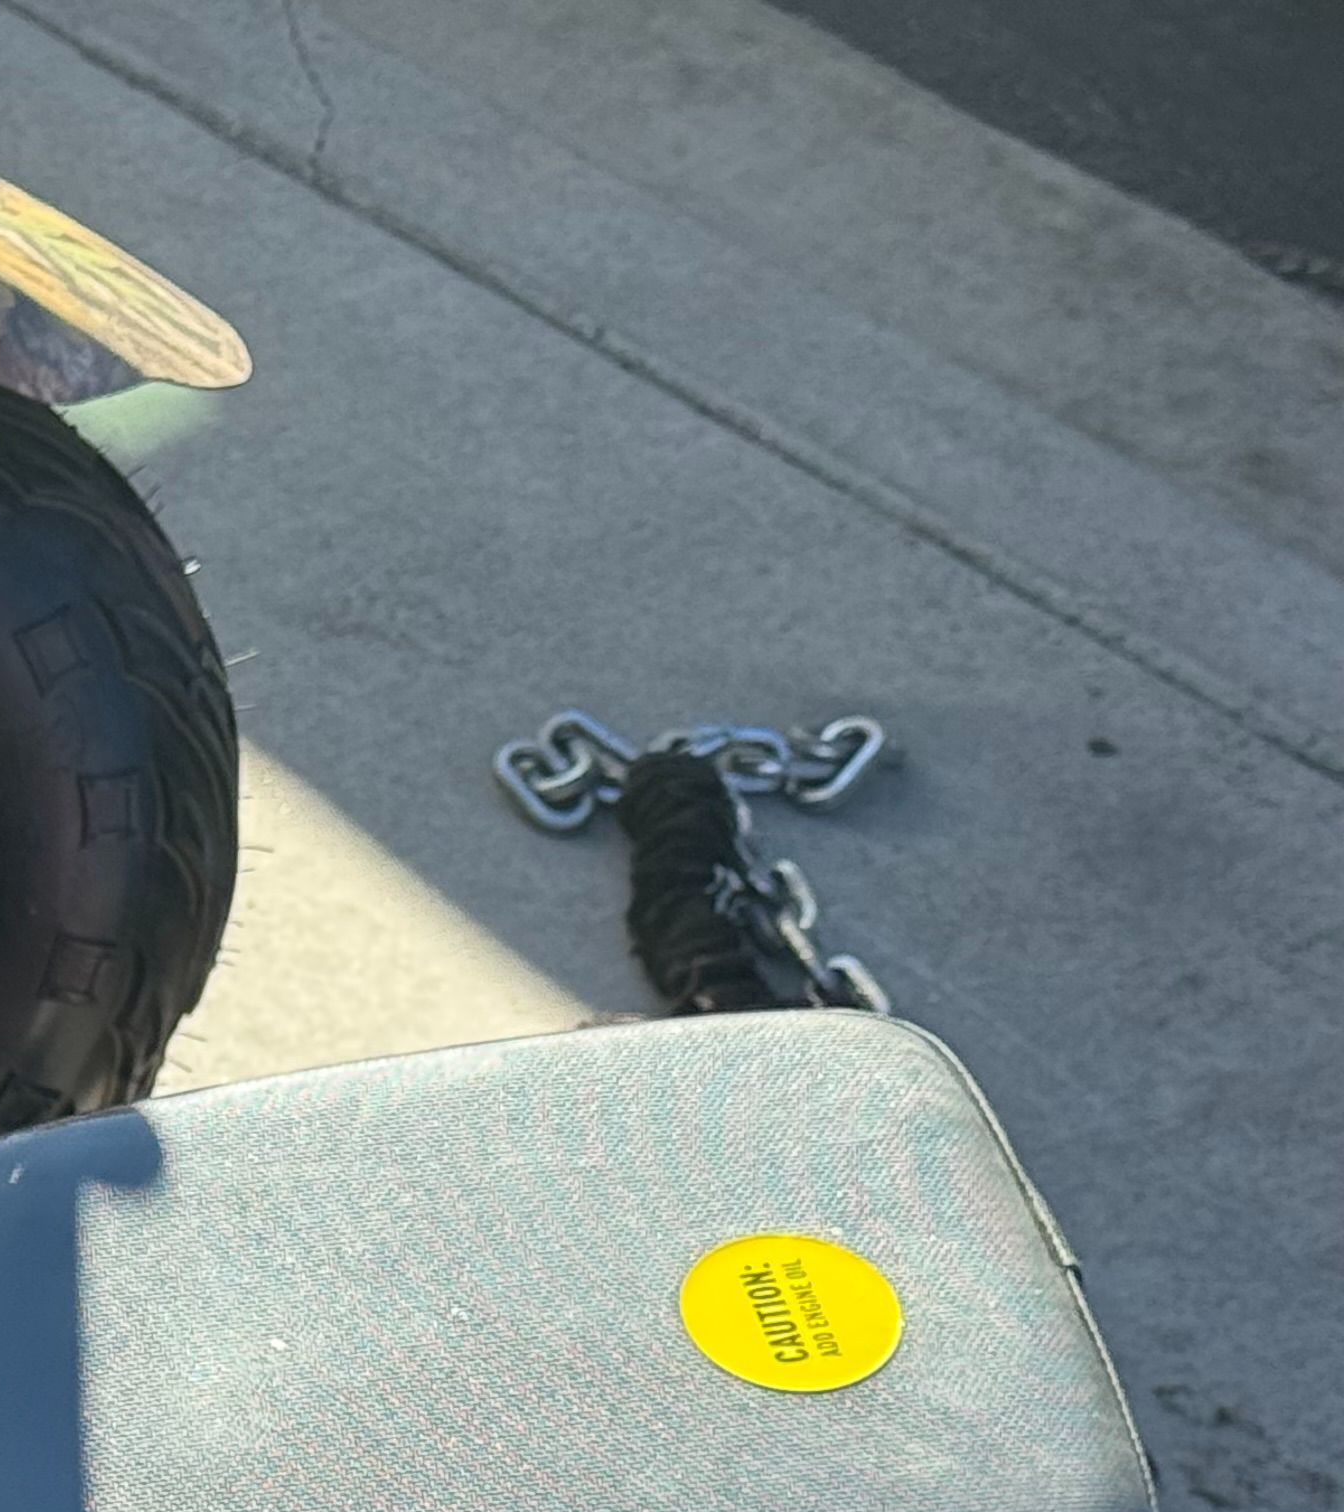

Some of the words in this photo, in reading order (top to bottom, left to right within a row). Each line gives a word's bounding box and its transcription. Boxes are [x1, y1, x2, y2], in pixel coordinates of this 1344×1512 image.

[782, 1259, 807, 1279] OIL
[740, 1262, 809, 1362] CAUTION:
[790, 1282, 829, 1329] ENGINE
[813, 1332, 842, 1356] ADD
